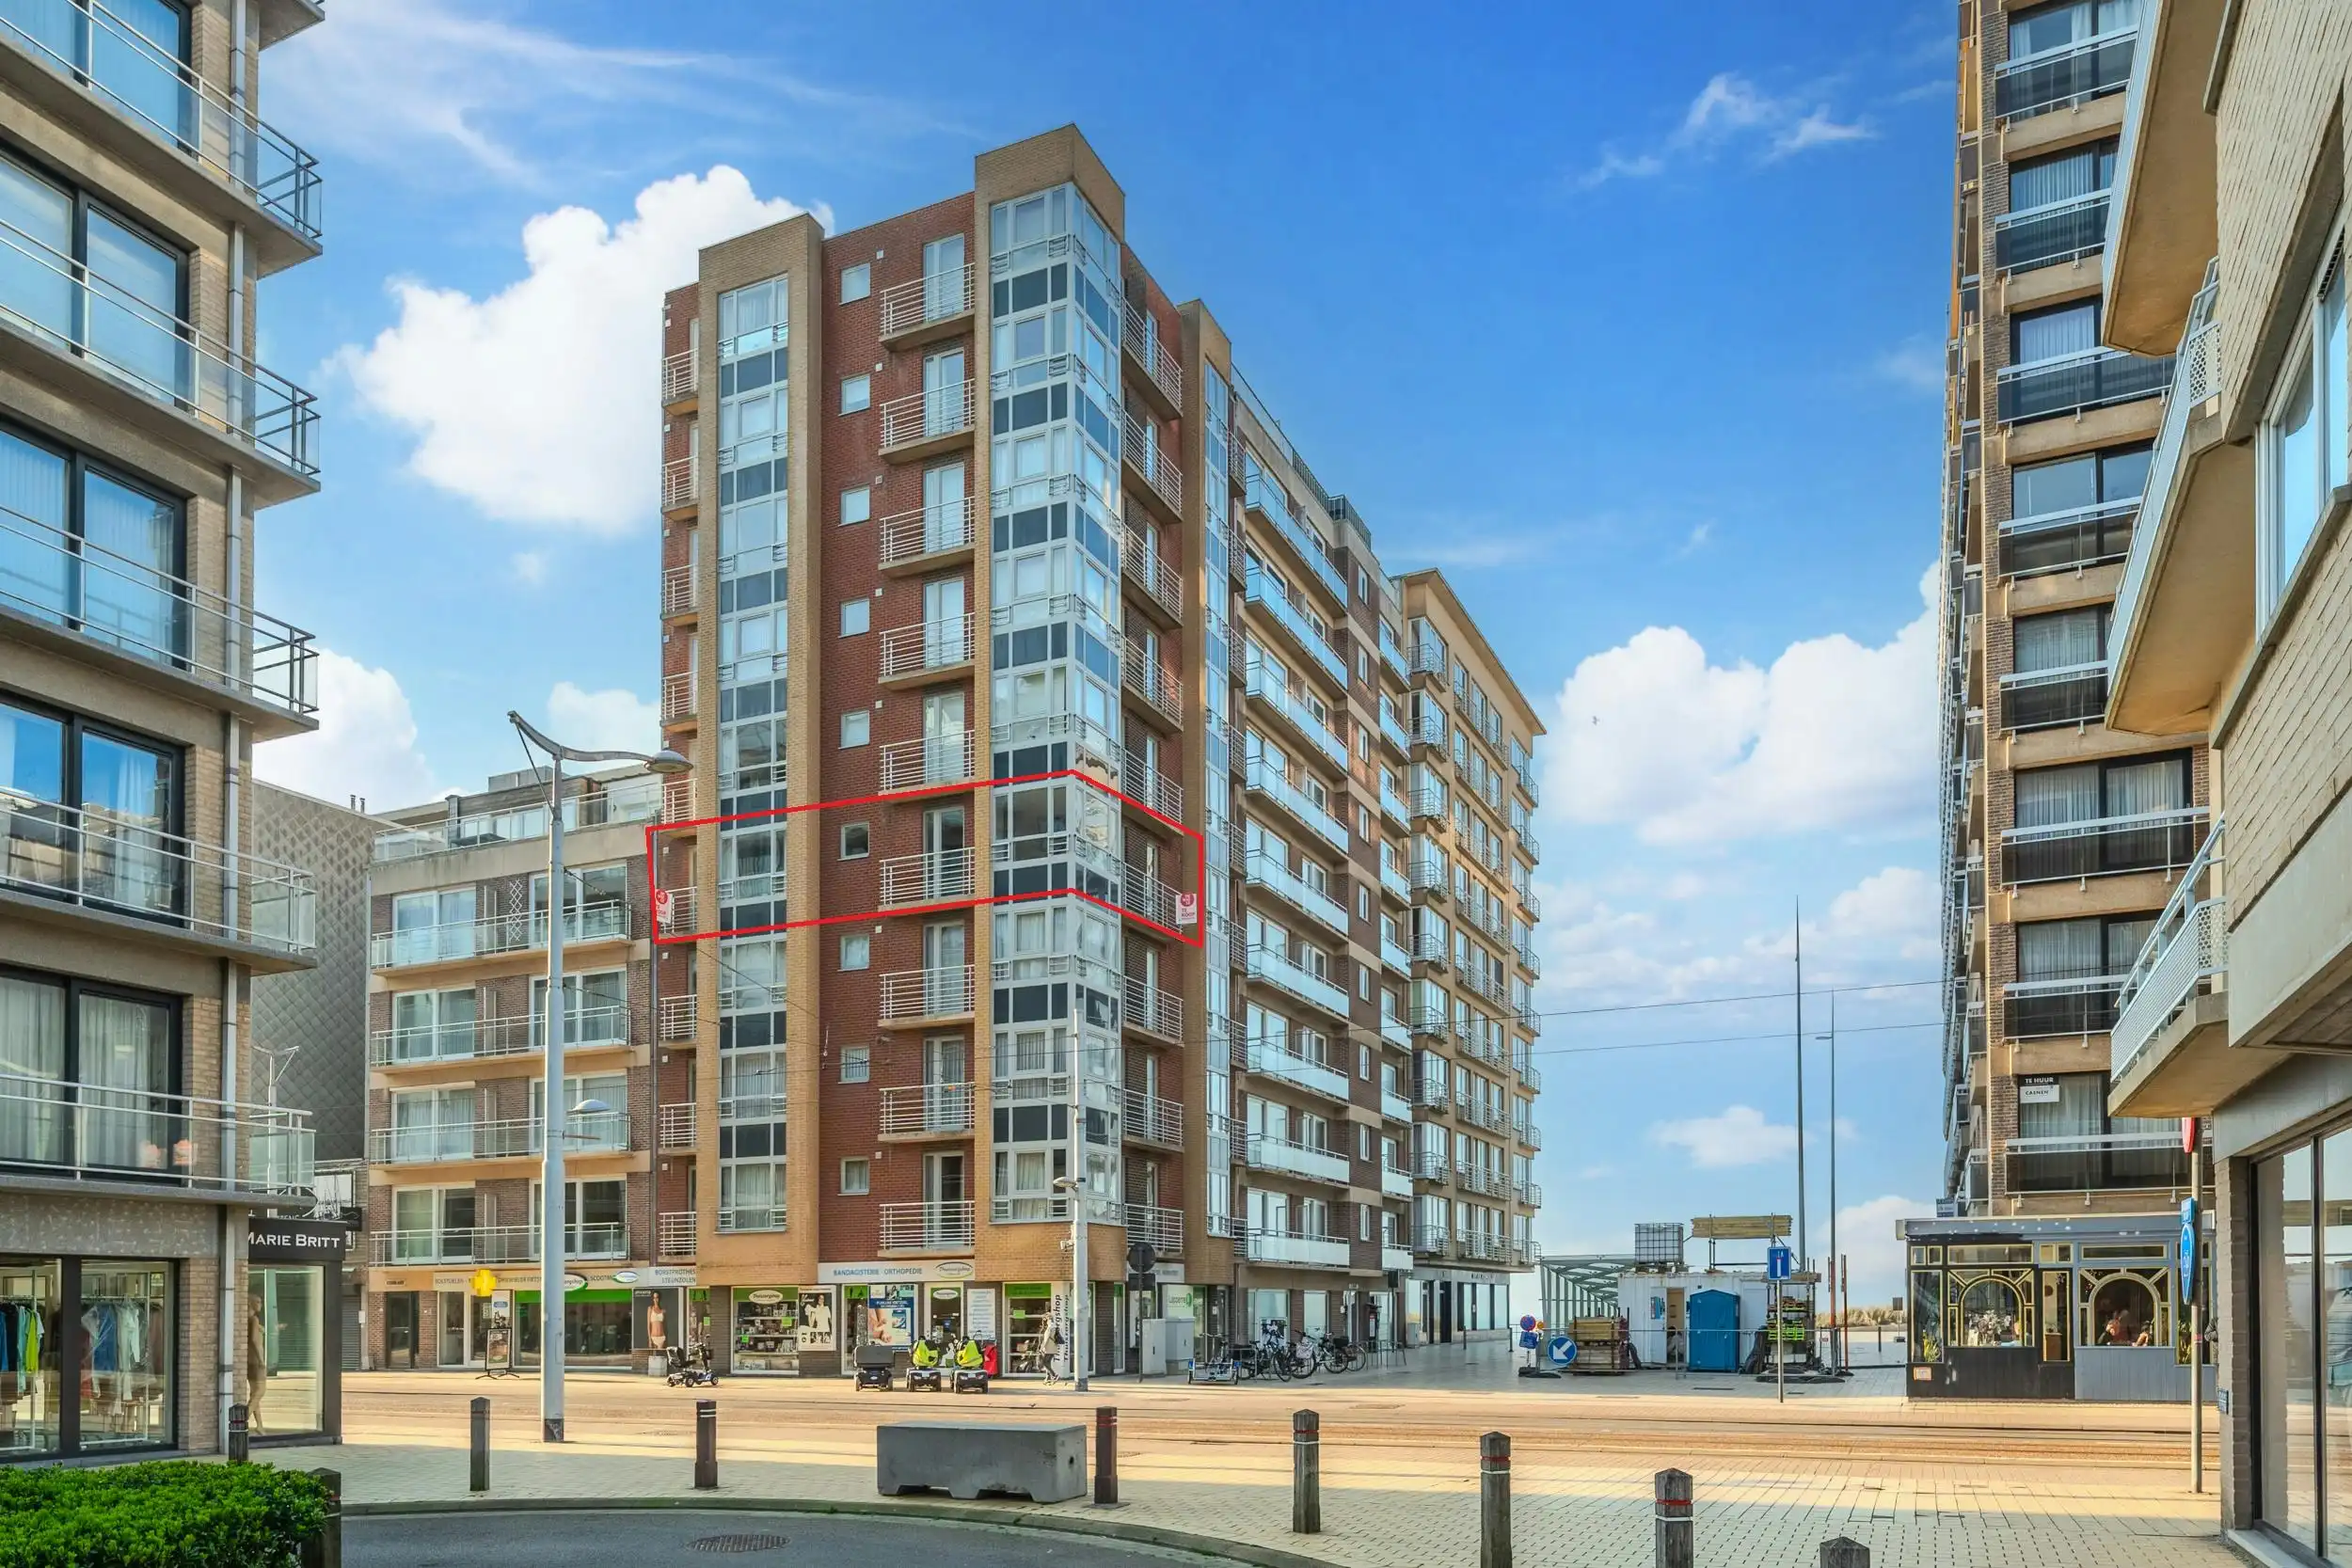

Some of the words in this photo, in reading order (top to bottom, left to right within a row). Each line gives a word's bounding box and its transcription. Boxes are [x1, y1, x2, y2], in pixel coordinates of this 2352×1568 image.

[248, 1231, 292, 1246] MARIE
[295, 1233, 340, 1248] BRITT
[884, 1267, 923, 1275] ORTHOPEDIE
